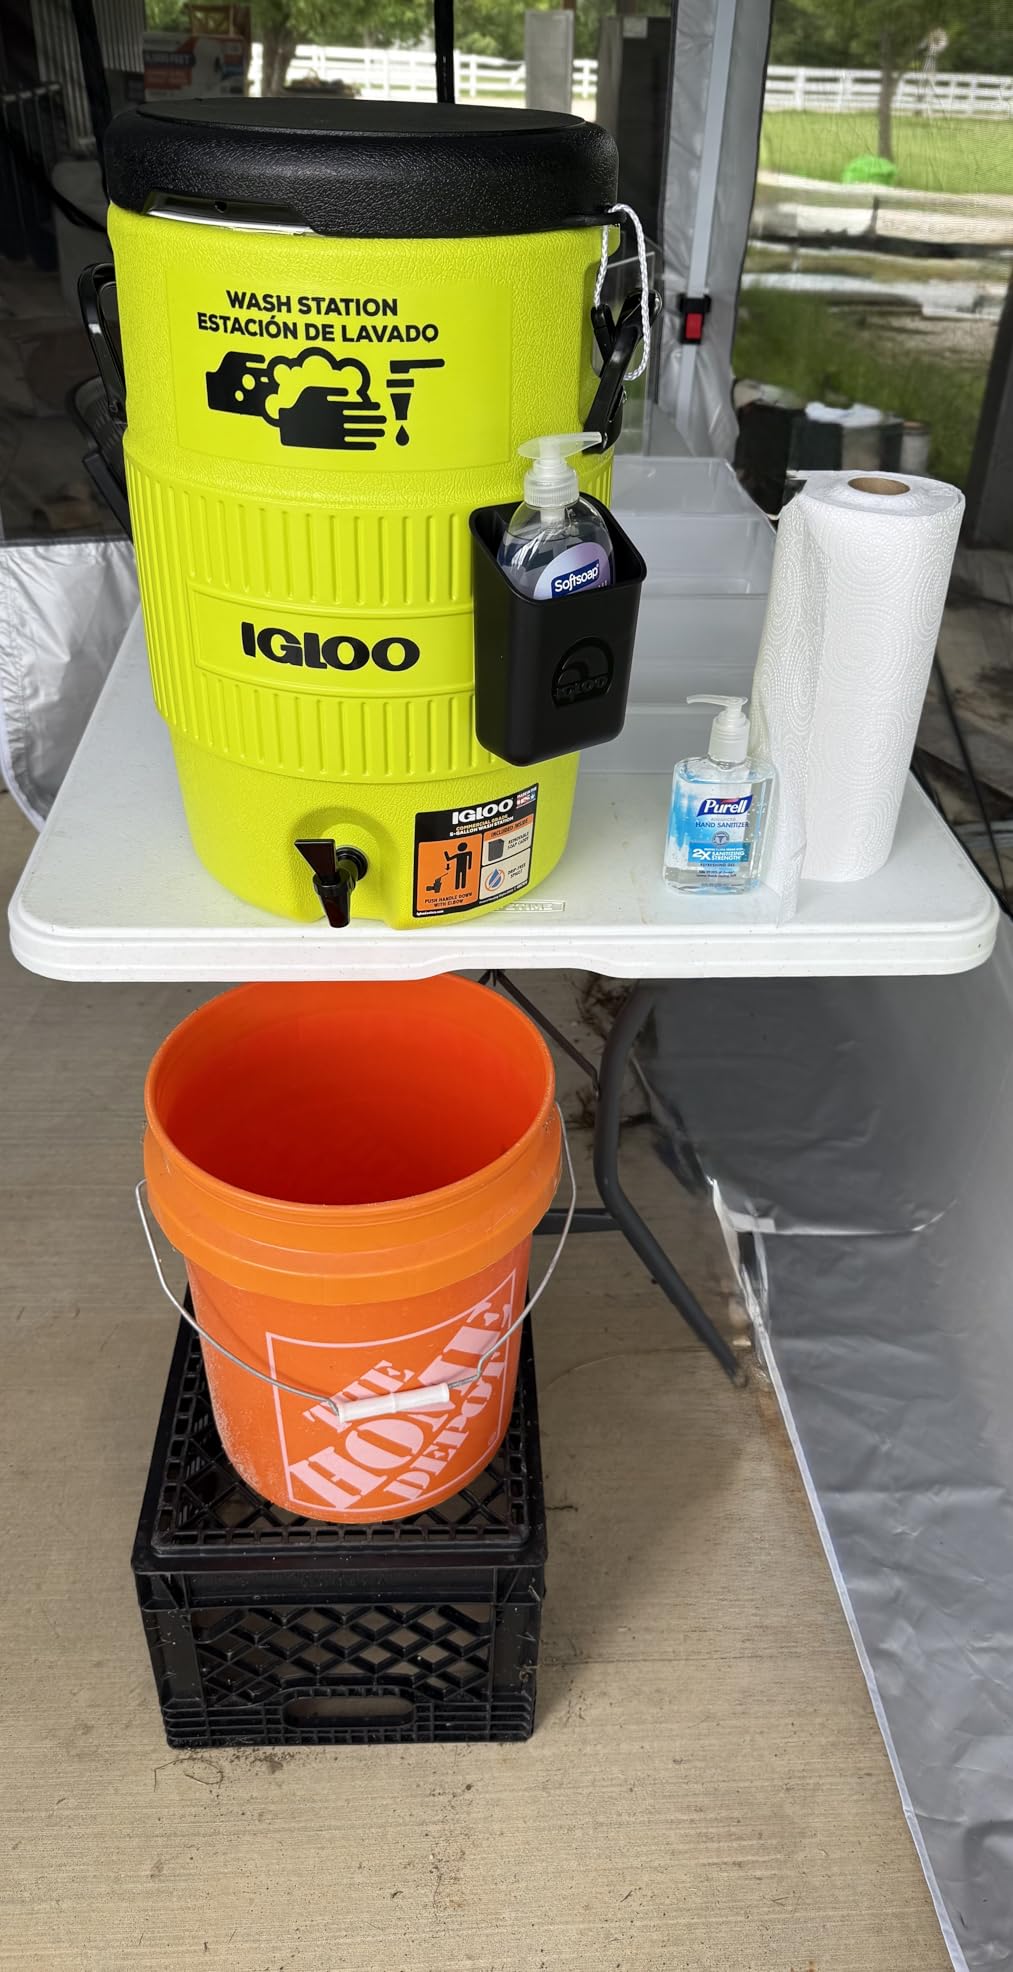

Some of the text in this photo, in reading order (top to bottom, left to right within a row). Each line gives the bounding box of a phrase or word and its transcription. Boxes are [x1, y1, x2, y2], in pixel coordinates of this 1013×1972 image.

[226, 289, 398, 317] WASH STATION
[197, 312, 439, 344] ESTACIÓN DE LAVADO
[554, 565, 598, 592] Softsoap
[240, 621, 420, 672] IGLOO
[452, 798, 514, 825] IGLOO
[703, 799, 748, 814] Purell
[456, 813, 508, 831] COMMERCIAL GRADE
[478, 823, 494, 832] WASH
[494, 816, 514, 827] STATION
[491, 818, 529, 838] INCLUDED INSIDE
[692, 848, 711, 861] 2X
[288, 1301, 511, 1509] HOME
[302, 1360, 415, 1433] THE
[383, 1351, 504, 1500] DEPOT
